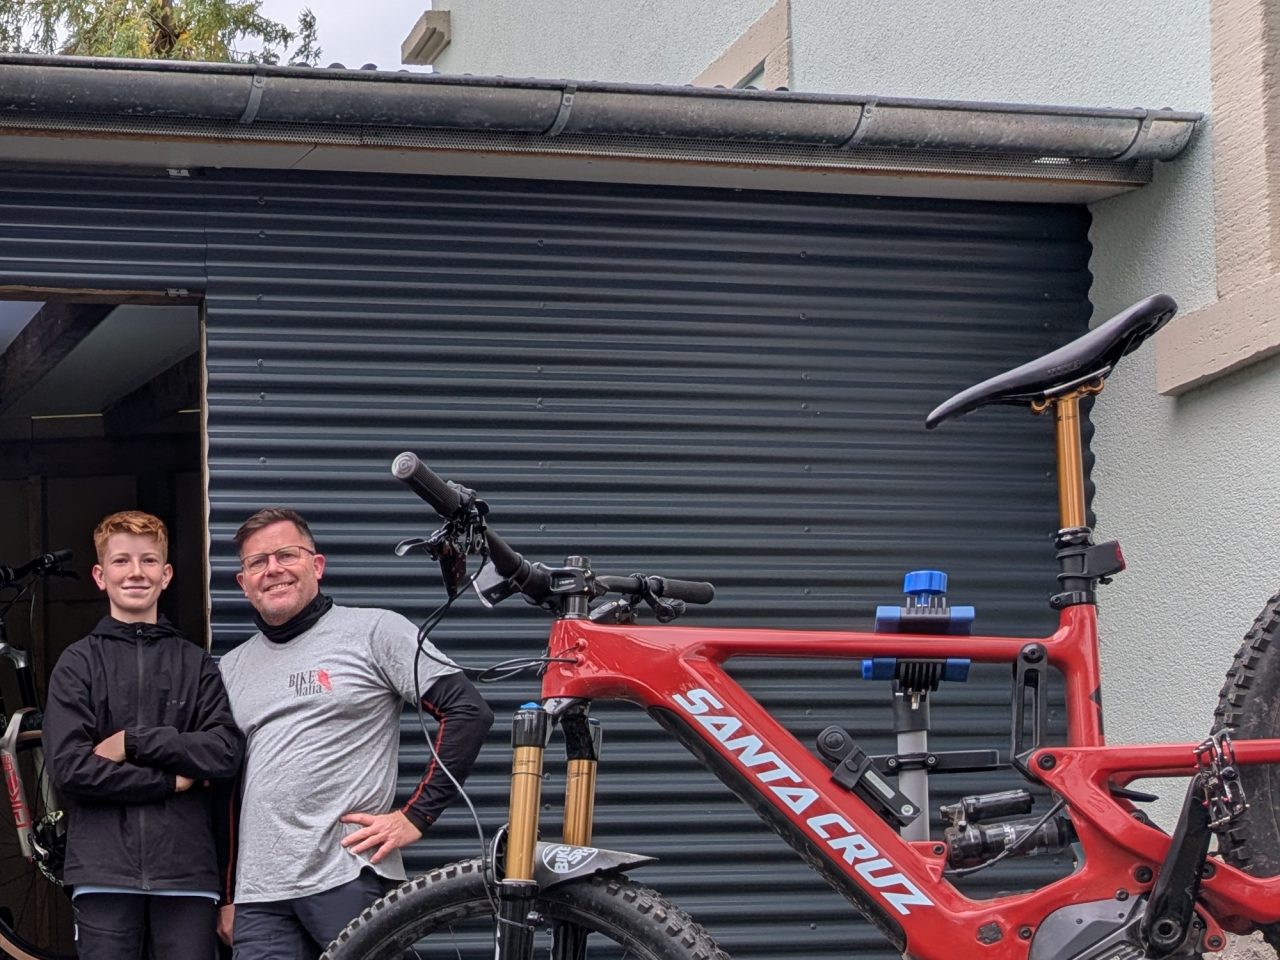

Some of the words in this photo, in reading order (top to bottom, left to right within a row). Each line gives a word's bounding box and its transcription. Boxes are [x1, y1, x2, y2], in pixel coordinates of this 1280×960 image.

[289, 670, 316, 688] BIKE
[672, 688, 820, 815] SANTA
[806, 813, 935, 916] CRUZ
